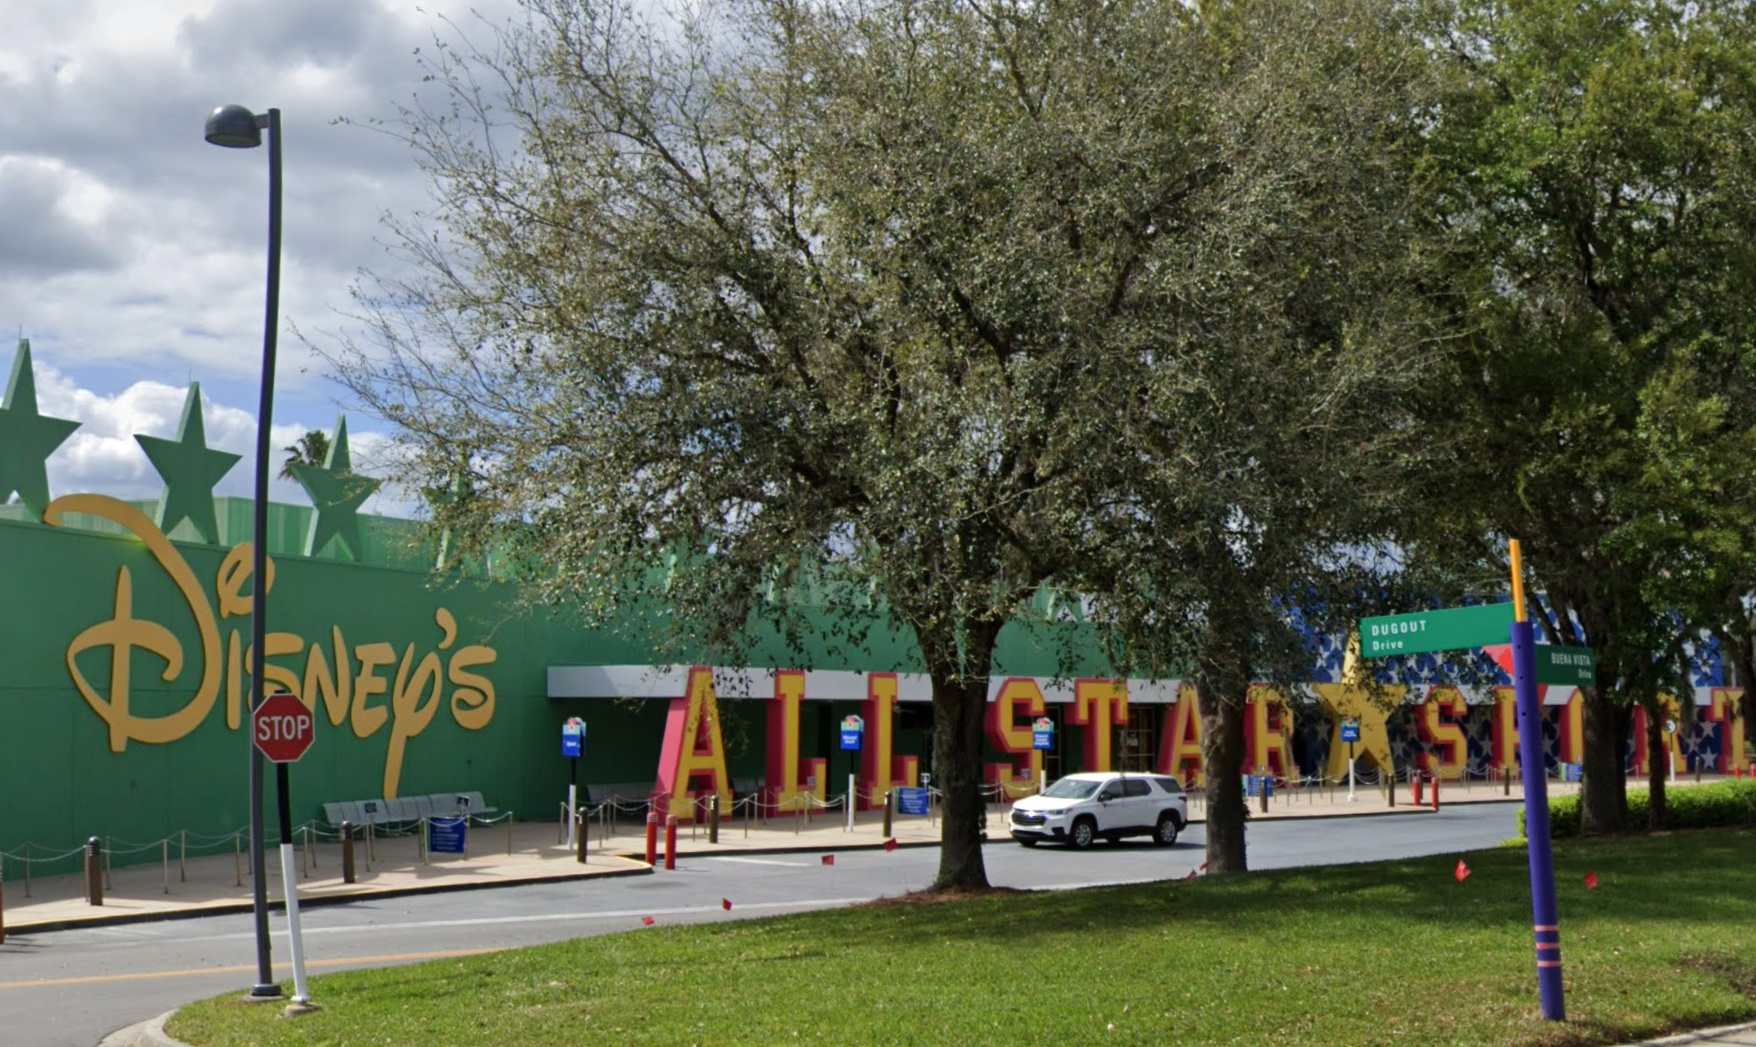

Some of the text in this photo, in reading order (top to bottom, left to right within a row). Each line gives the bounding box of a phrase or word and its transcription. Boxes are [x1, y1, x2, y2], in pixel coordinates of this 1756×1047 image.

[1371, 620, 1427, 636] DUGOUT
[1372, 640, 1404, 651] Drive
[1551, 652, 1591, 667] BUENA VISTA
[258, 714, 310, 741] STOP
[648, 666, 919, 825] ALL
[984, 677, 1300, 802] STAR
